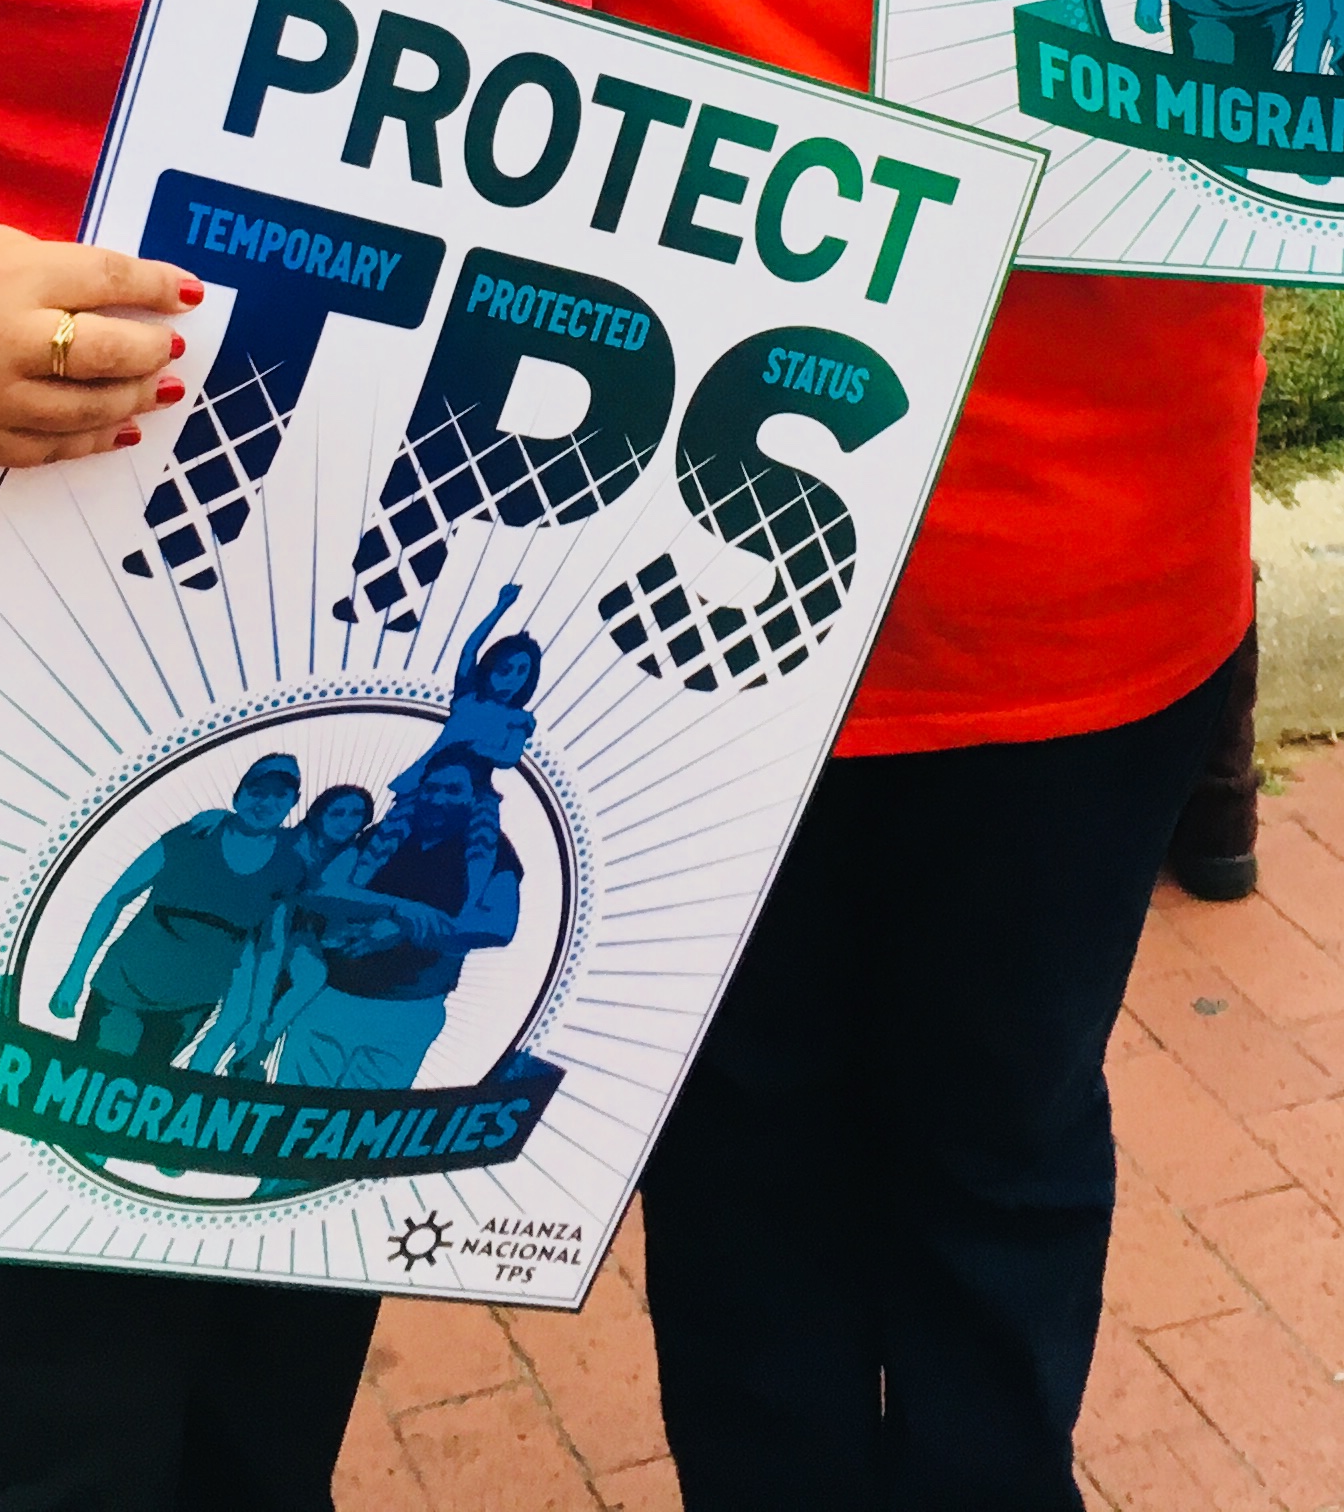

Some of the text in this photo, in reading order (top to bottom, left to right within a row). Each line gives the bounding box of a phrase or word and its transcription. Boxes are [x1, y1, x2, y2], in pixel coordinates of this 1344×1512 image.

[1037, 40, 1142, 126] FOR
[186, 201, 871, 405] TEMPORARY PROTECTED STATUS
[121, 168, 910, 693] TPS
[32, 1058, 272, 1153] MIGRANT
[281, 1098, 532, 1160] FAMILIES
[459, 1237, 582, 1266] NACIONAL
[479, 1216, 583, 1243] ALIANZA
[495, 1263, 537, 1284] TPS
